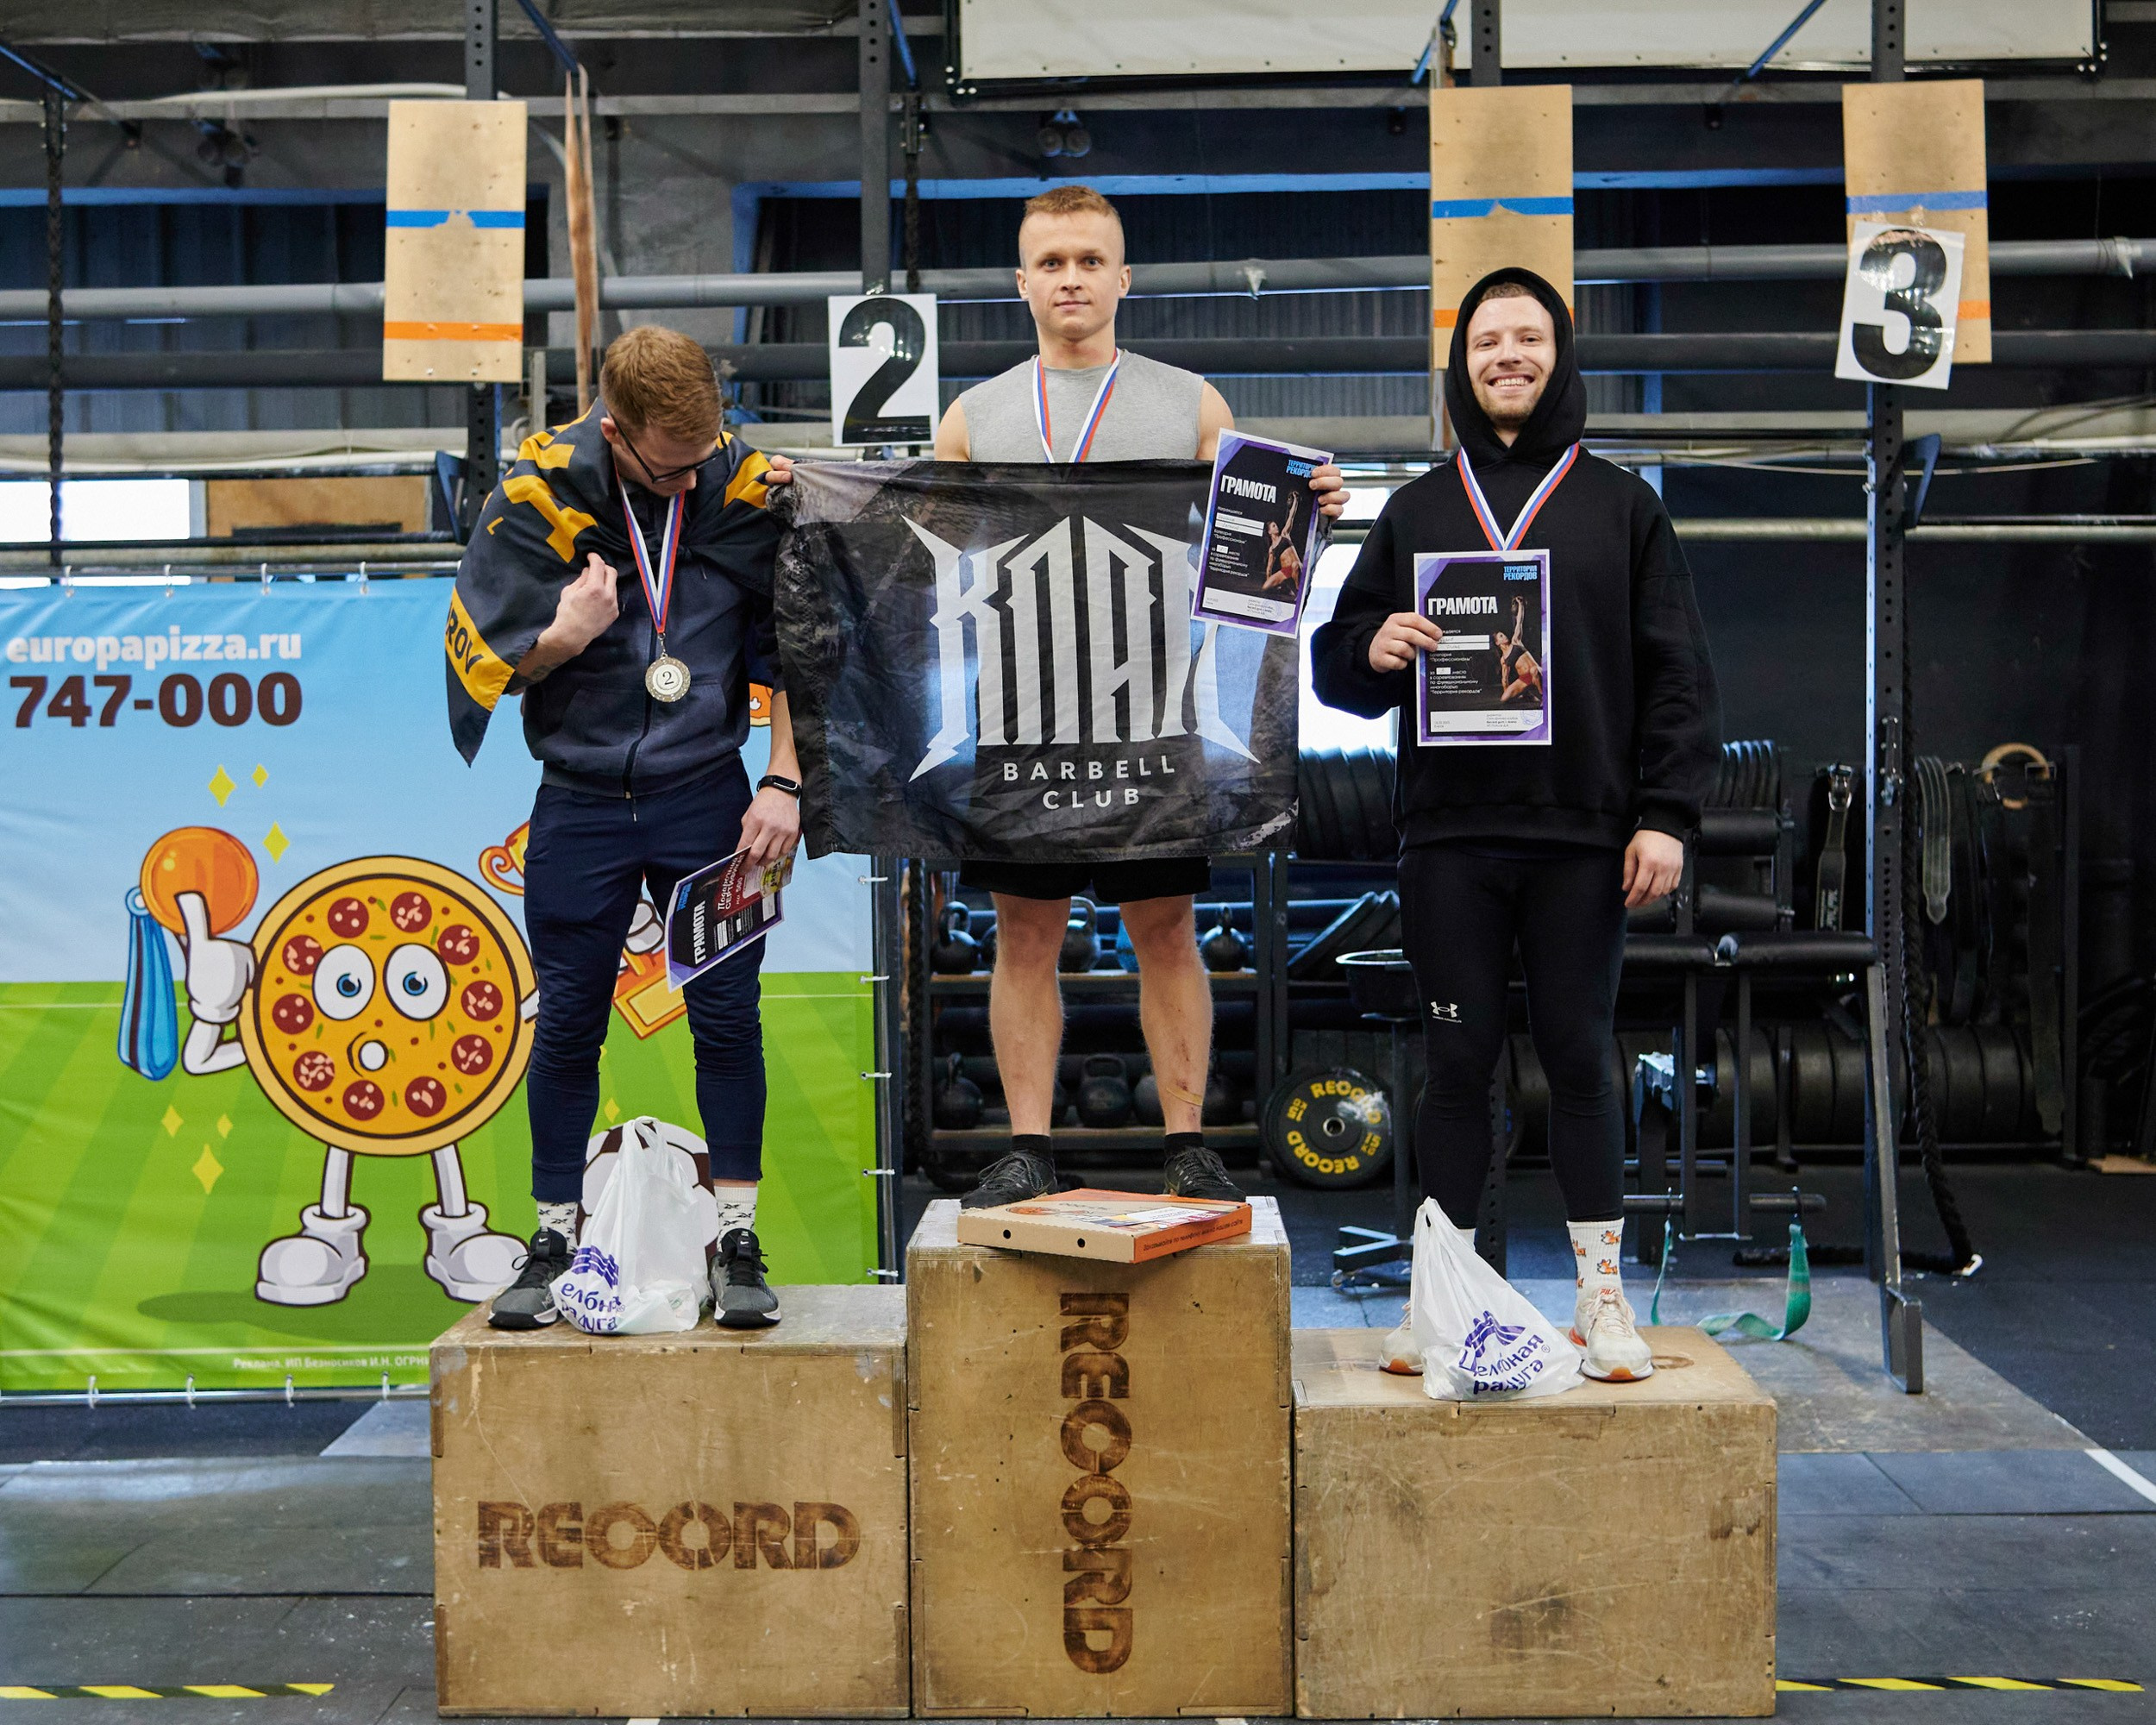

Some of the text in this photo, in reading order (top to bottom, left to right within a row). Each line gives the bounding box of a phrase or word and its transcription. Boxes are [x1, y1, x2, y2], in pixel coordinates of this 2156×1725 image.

[1852, 229, 1946, 380] 3
[839, 298, 931, 443] 2
[1220, 474, 1276, 503] ГРАМОТА
[1504, 572, 1537, 581] РЕКОРДОВ
[1427, 595, 1498, 616] ГРАМОТА
[7, 625, 302, 671] europapizza.ru
[9, 672, 302, 728] 747-000
[662, 671, 674, 685] 2
[1003, 755, 1175, 781] BARBELL
[1042, 787, 1140, 809] CLUB
[693, 900, 706, 964] ГРАМОТА
[1310, 1080, 1382, 1124] RECOD
[1287, 1130, 1360, 1174] RECORD
[1060, 1293, 1132, 1673] RECORD
[478, 1501, 860, 1571] RECORD
